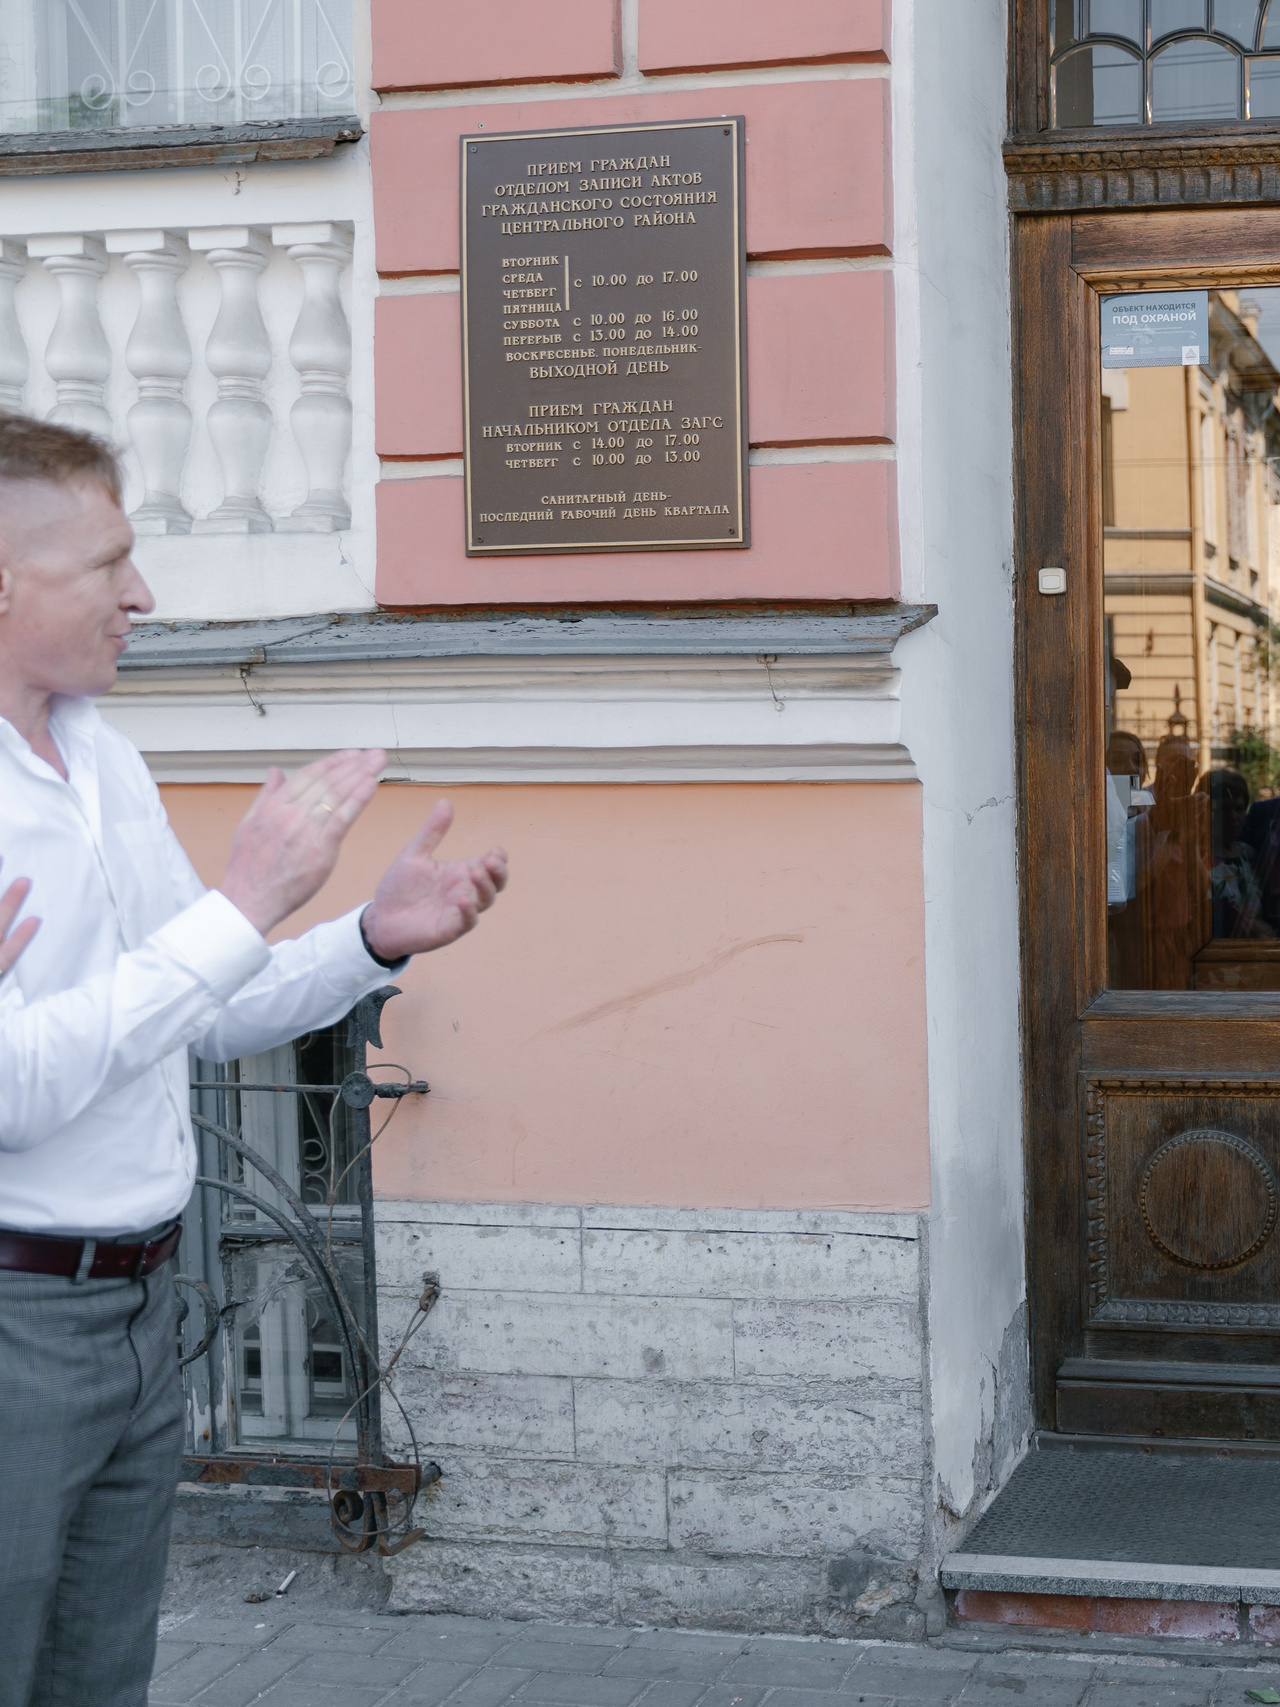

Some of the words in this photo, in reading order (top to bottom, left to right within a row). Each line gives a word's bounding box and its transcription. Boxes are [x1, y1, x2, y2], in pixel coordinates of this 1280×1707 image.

[527, 162, 582, 176] ПРИЕМ
[590, 156, 671, 171] ГРАЖДАН
[495, 180, 569, 197] ОТДЕЛОМ
[580, 177, 642, 191] ЗАПИСИ
[652, 173, 702, 186] АКТОВ
[482, 199, 612, 217] ГРАЖДАНСКОГО
[621, 192, 717, 209] СОСТОЯНИЯ
[502, 217, 624, 236] ЦЕНТРАЛЬНОГО
[634, 211, 696, 227] РАЙОНА
[502, 256, 559, 268] ВТОРНИК
[503, 272, 543, 284] СРЕДА
[592, 275, 626, 287] 10.00
[662, 271, 698, 283] 17.00
[503, 288, 556, 299] ЧЕТВЕРГ
[503, 303, 562, 315] ПЯТНИЦА
[1146, 303, 1196, 312] НАХОДИТСЯ
[504, 319, 560, 330] СУББОТА
[591, 313, 625, 325] 10.00
[662, 310, 698, 322] 16.00
[1112, 315, 1138, 325] ПОД
[1141, 310, 1196, 323] ОХРАНОЙ
[503, 334, 562, 346] ПЕРЕРЫВ
[591, 329, 625, 341] 13.00
[662, 326, 698, 338] 14.00
[530, 360, 618, 379] ВЫХОДНОЙ
[626, 361, 669, 375] ДЕНЬ
[529, 404, 583, 418] ПРИЕМ
[593, 400, 673, 415] ГРАЖДАН
[483, 421, 599, 438] НАЧАЛЬНИКОМ
[608, 419, 672, 434] ОТДЕЛА
[681, 417, 723, 429] ЗАГС
[506, 441, 562, 453] ВТОРНИК
[592, 437, 624, 449] 14.00
[665, 434, 699, 446] 17.00
[506, 457, 558, 469] ЧЕТВЕРГ
[592, 454, 624, 465] 10.00
[665, 450, 700, 462] 13.00
[541, 491, 626, 505] САНИТАРНЫЙ
[480, 509, 553, 523] ПОСЛЕДНИЙ
[561, 507, 616, 520] РАБОЧИЙ
[623, 508, 656, 518] ДЕНЬ
[665, 505, 730, 516] КВАРТАЛА
